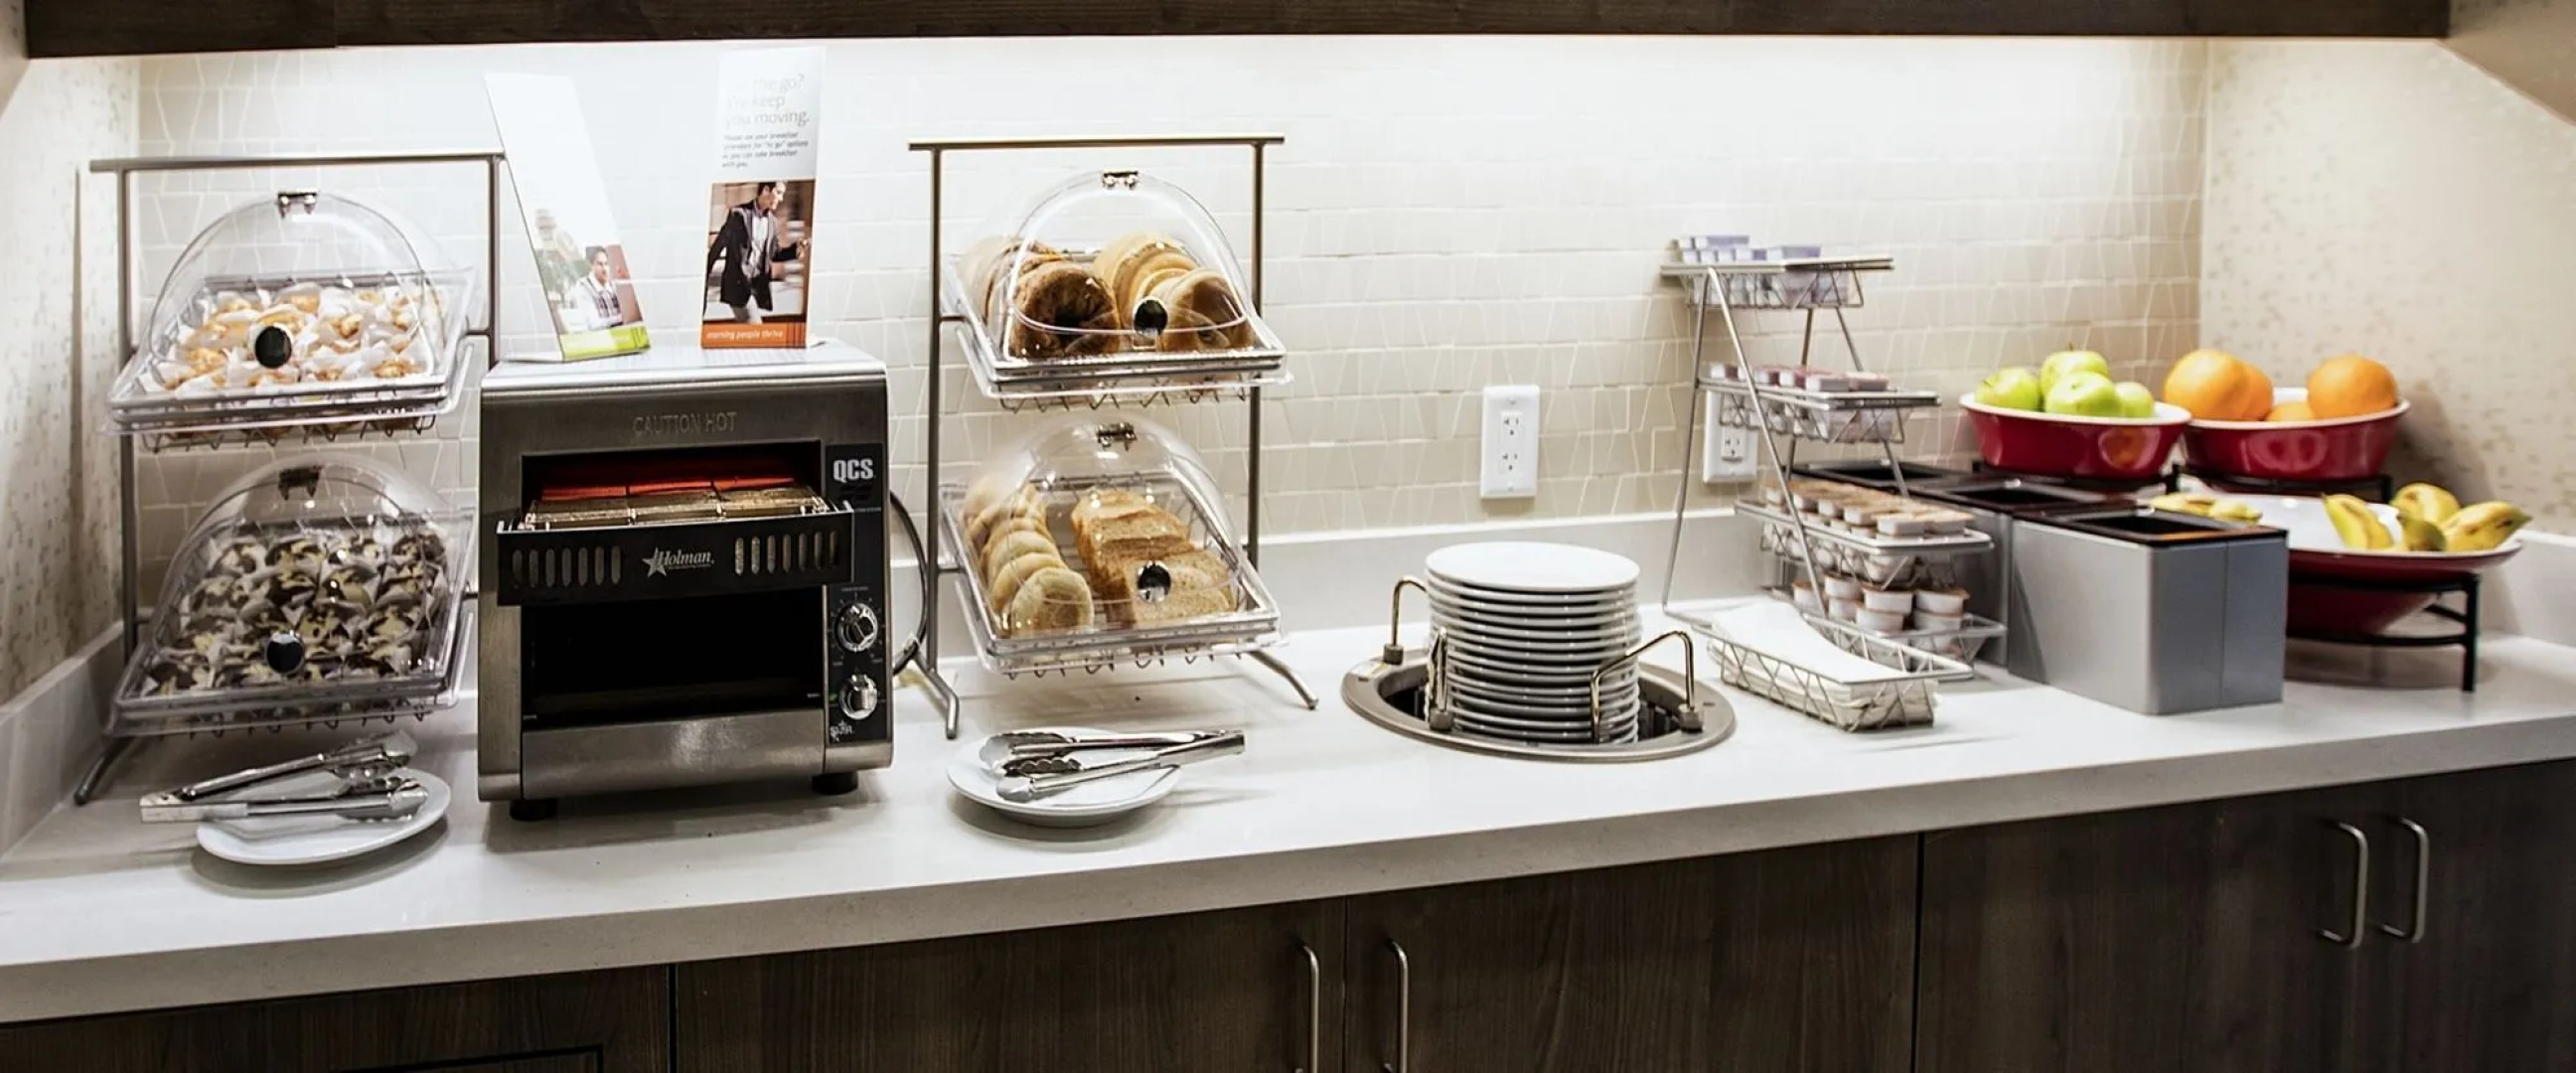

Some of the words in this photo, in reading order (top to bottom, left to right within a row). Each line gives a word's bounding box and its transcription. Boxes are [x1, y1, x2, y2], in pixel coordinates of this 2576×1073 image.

[632, 413, 701, 437] CAUTION
[705, 411, 737, 433] HOT
[833, 458, 874, 483] QCS
